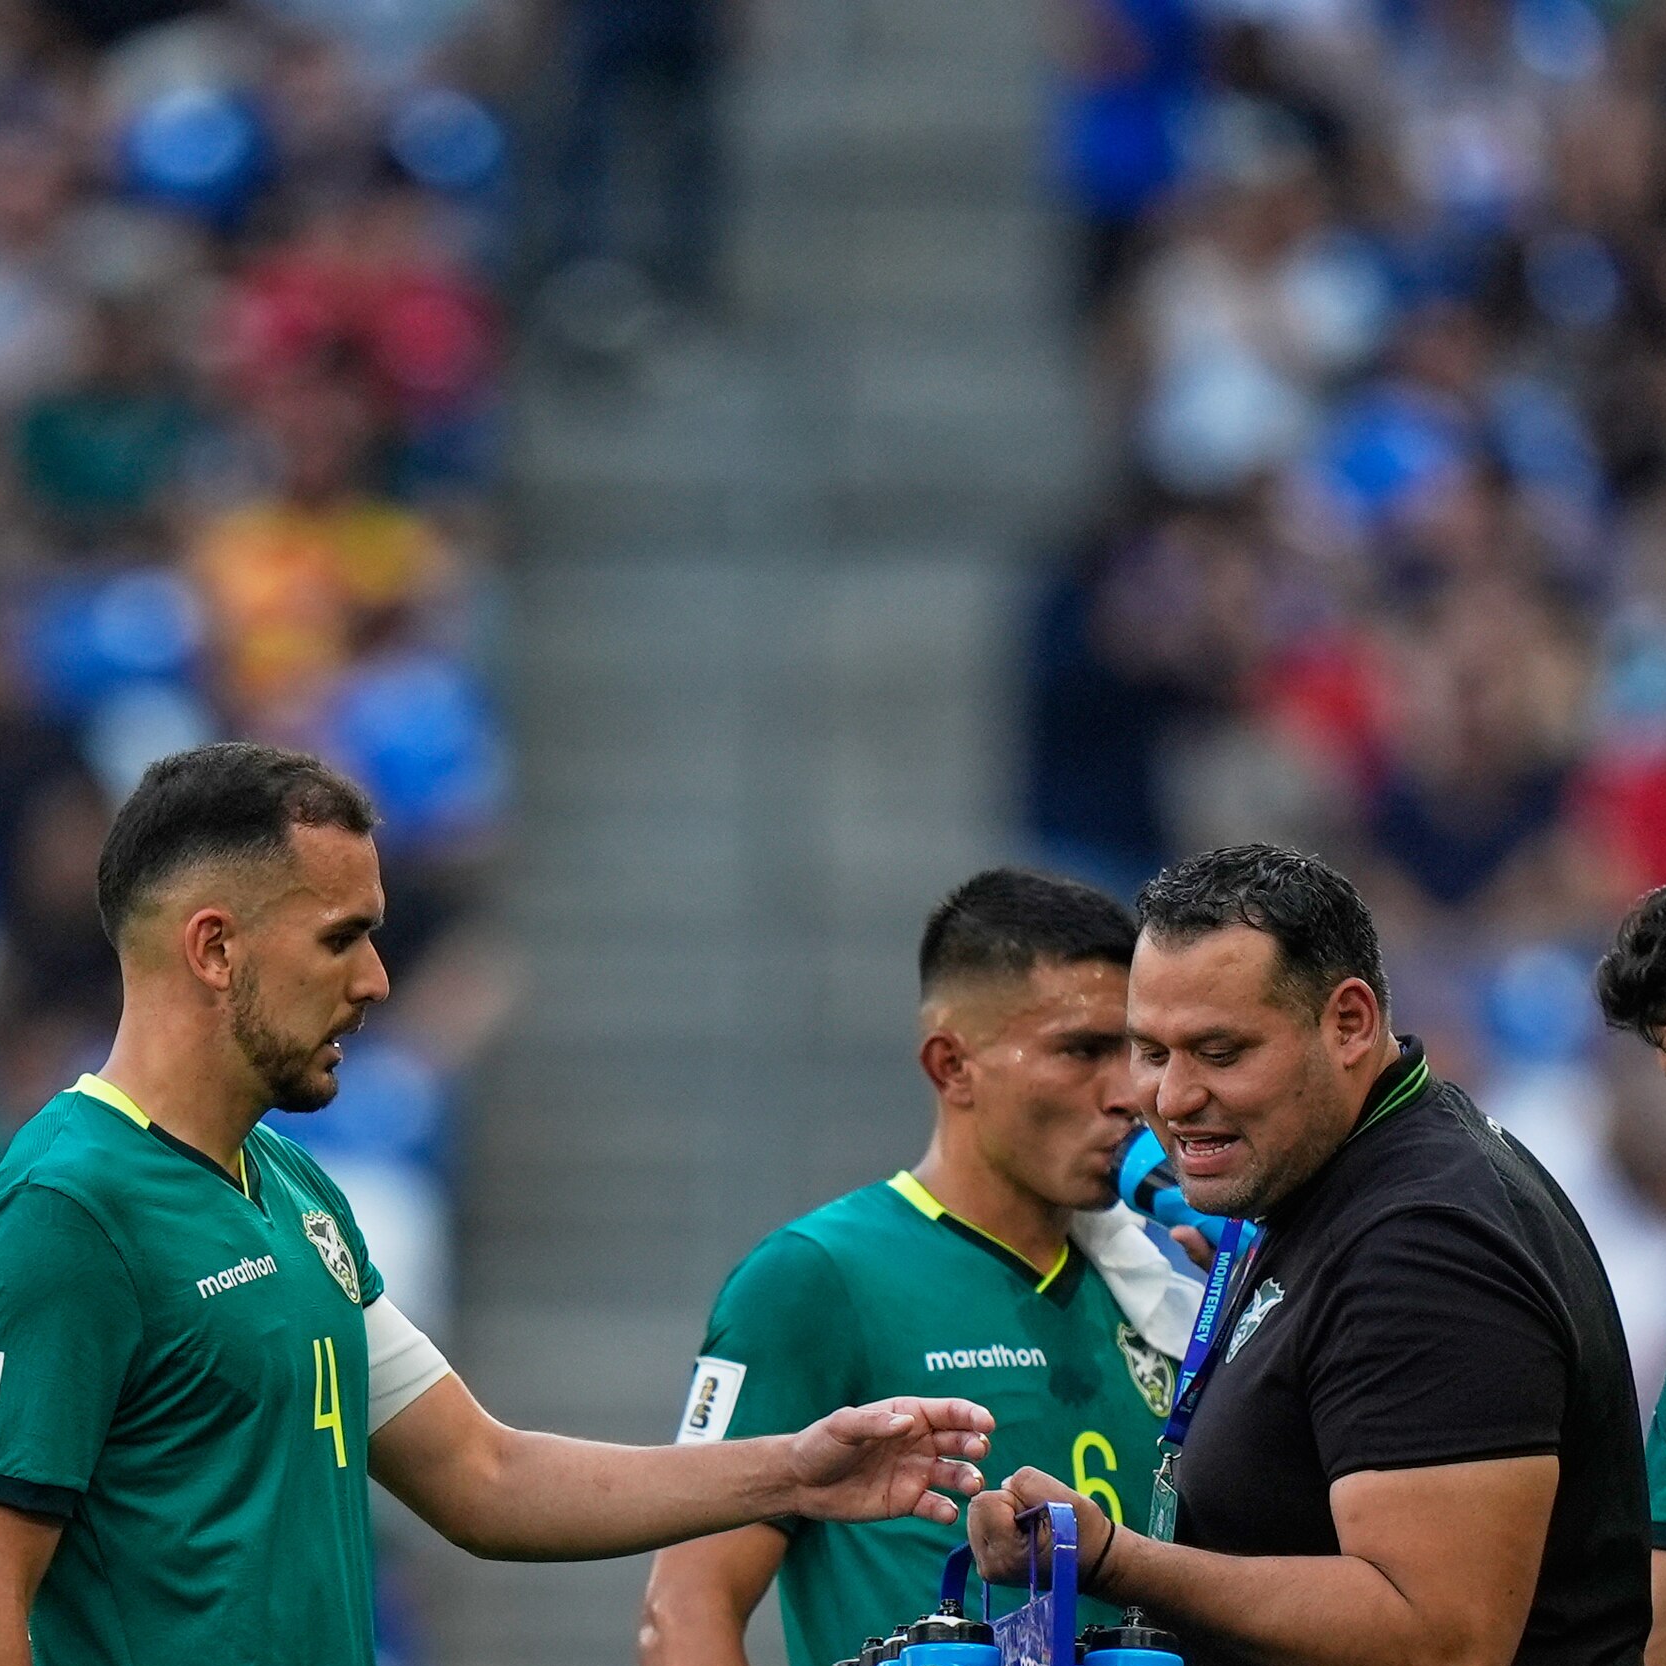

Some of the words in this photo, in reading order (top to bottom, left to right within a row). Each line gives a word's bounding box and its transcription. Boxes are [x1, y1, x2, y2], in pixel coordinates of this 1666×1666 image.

[196, 1254, 278, 1299] marathon
[925, 1343, 1047, 1372] marathon
[313, 1336, 347, 1468] 4
[1072, 1431, 1124, 1525] 6
